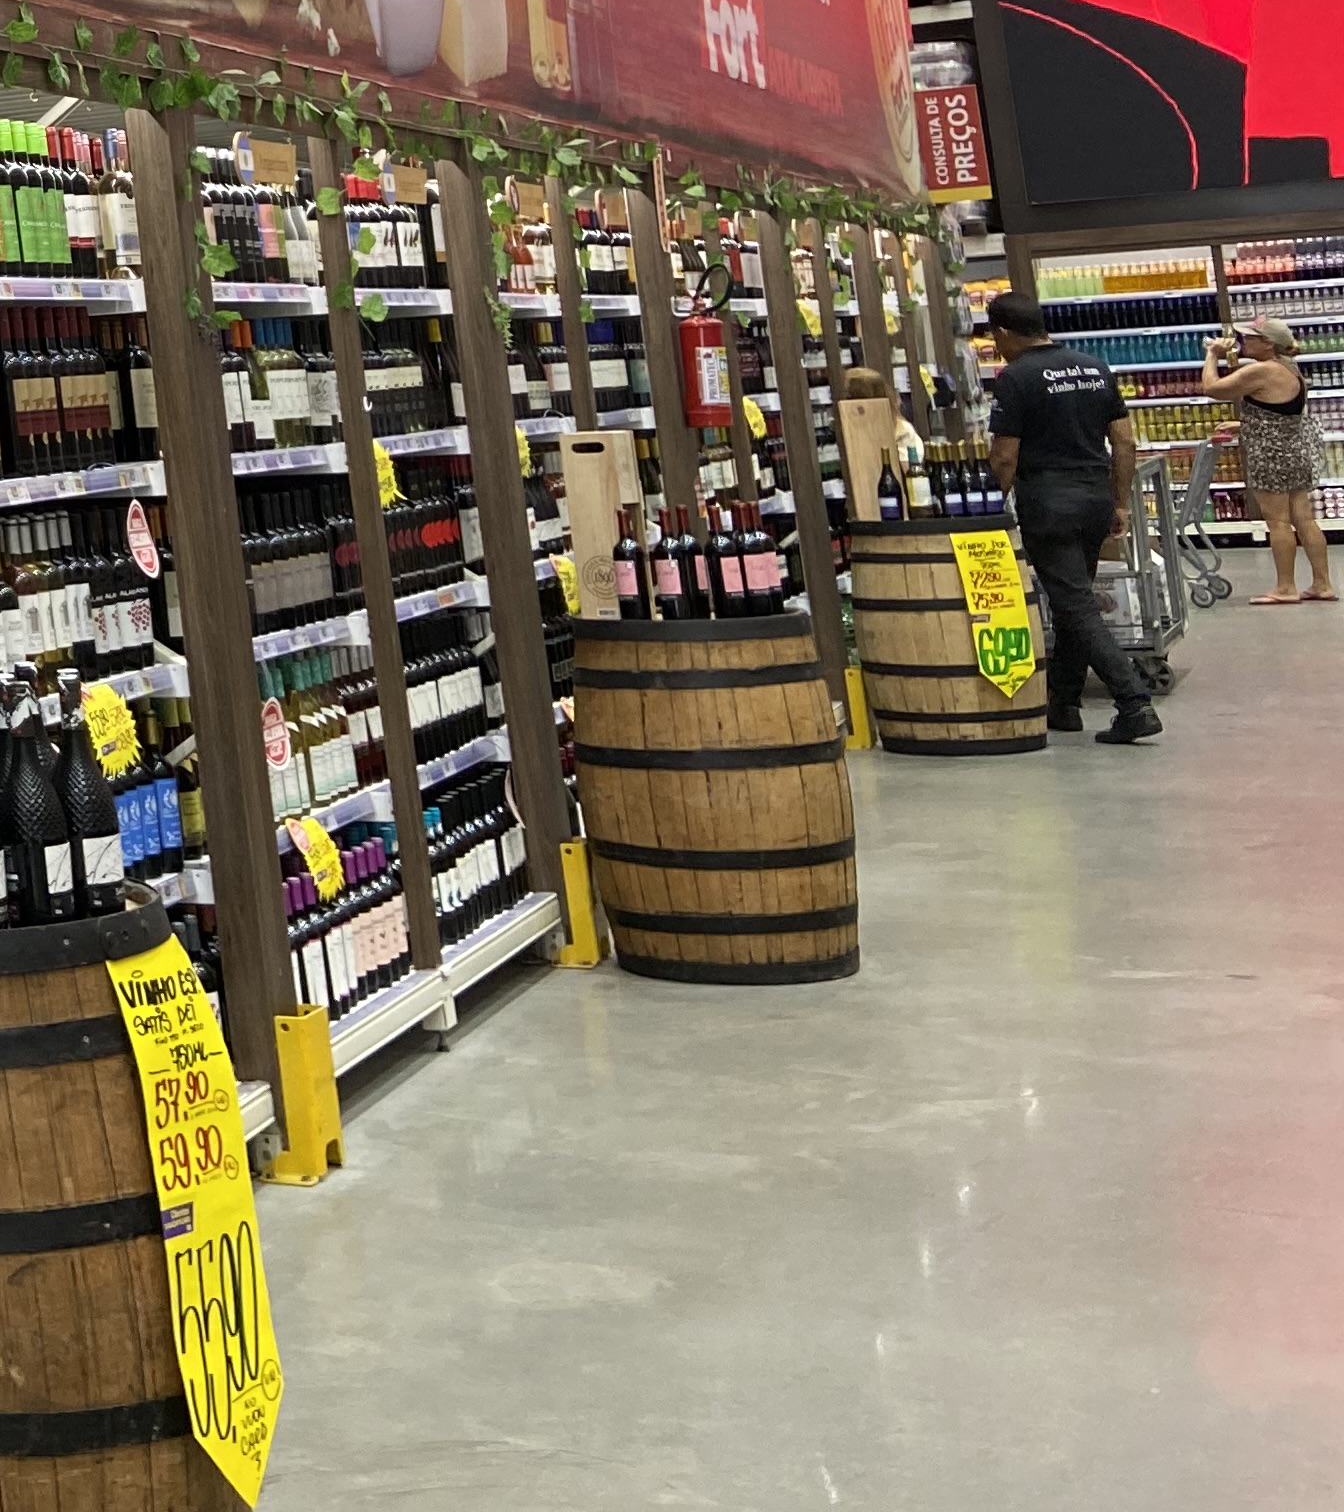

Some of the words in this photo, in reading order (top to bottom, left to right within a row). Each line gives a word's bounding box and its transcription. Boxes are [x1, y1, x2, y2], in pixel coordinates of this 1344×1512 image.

[925, 97, 938, 115] DE
[928, 117, 949, 186] CONSULTA
[945, 94, 978, 184] PREÇOS
[1043, 369, 1066, 380] Que
[1067, 365, 1082, 376] tal
[1047, 381, 1076, 394] vinho
[119, 969, 176, 1008] VINHO
